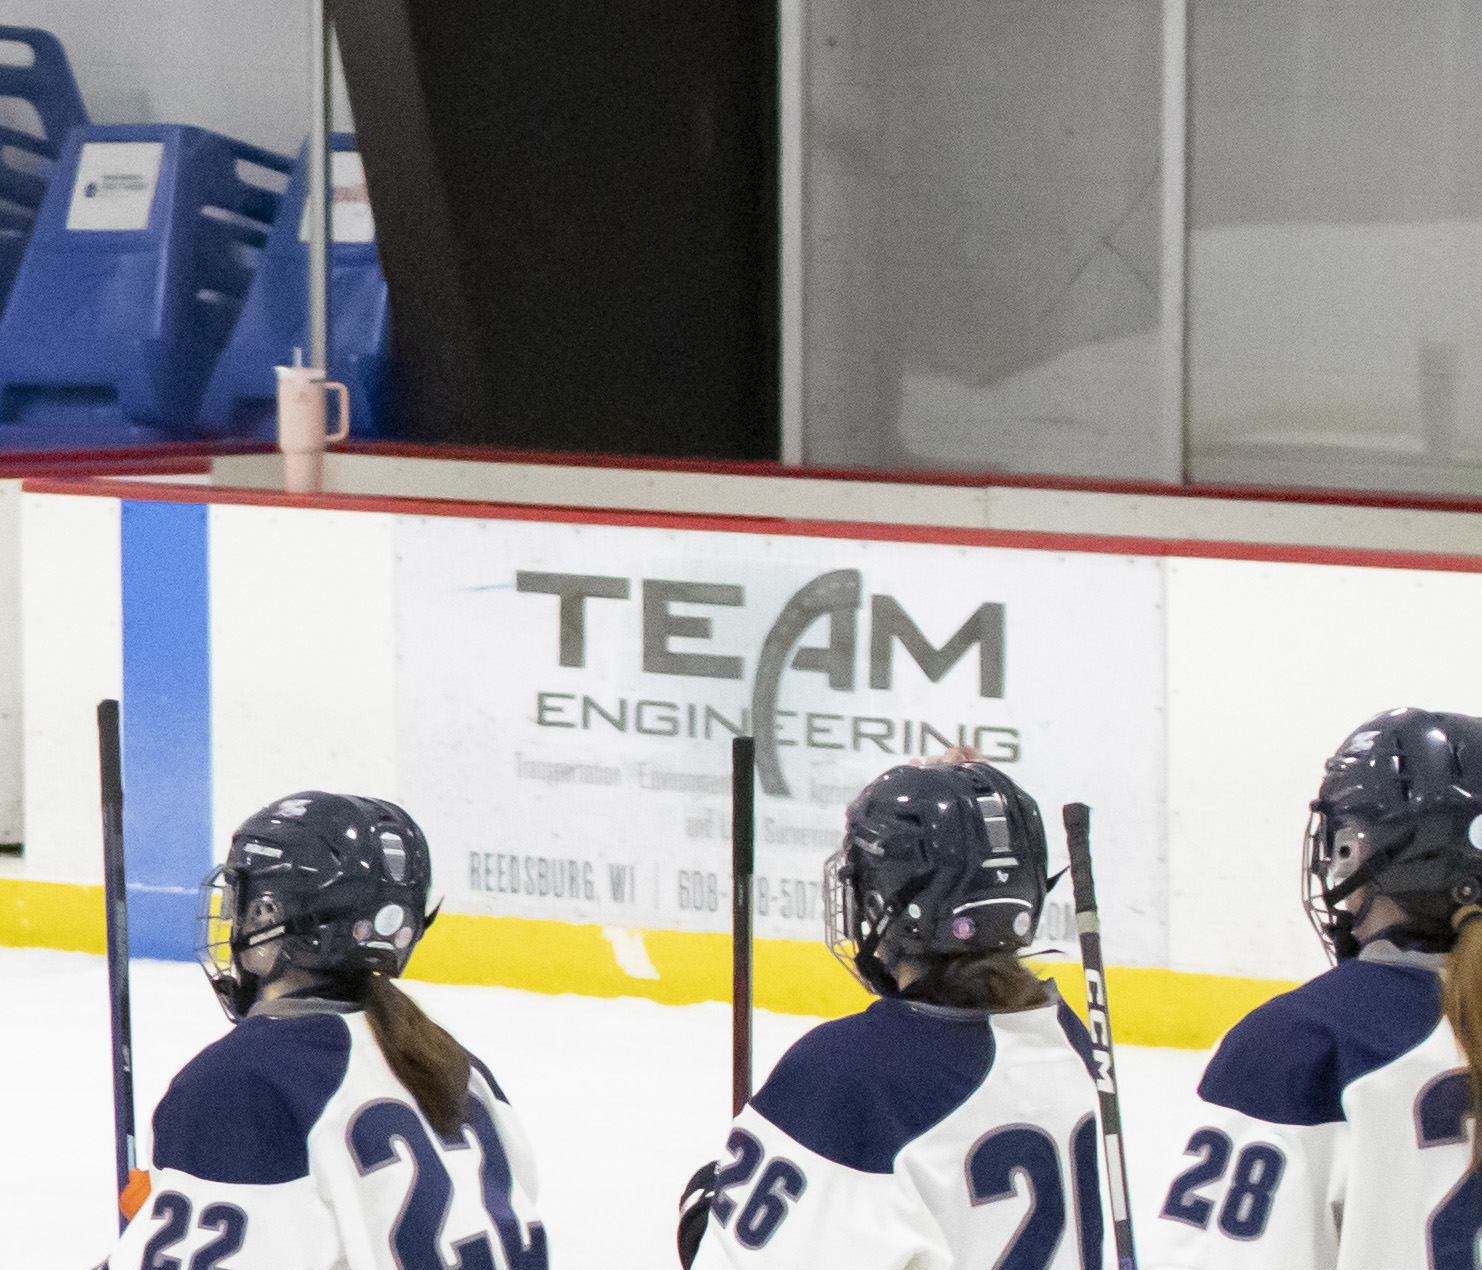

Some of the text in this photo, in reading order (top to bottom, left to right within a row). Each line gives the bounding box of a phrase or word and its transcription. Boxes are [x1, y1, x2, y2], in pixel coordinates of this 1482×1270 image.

[515, 567, 1008, 798] TEAM
[536, 692, 1021, 763] ENGINEERING
[609, 862, 636, 904] WI
[1085, 967, 1115, 1094] CCM
[712, 1126, 809, 1252] 26
[1159, 1127, 1287, 1242] 28
